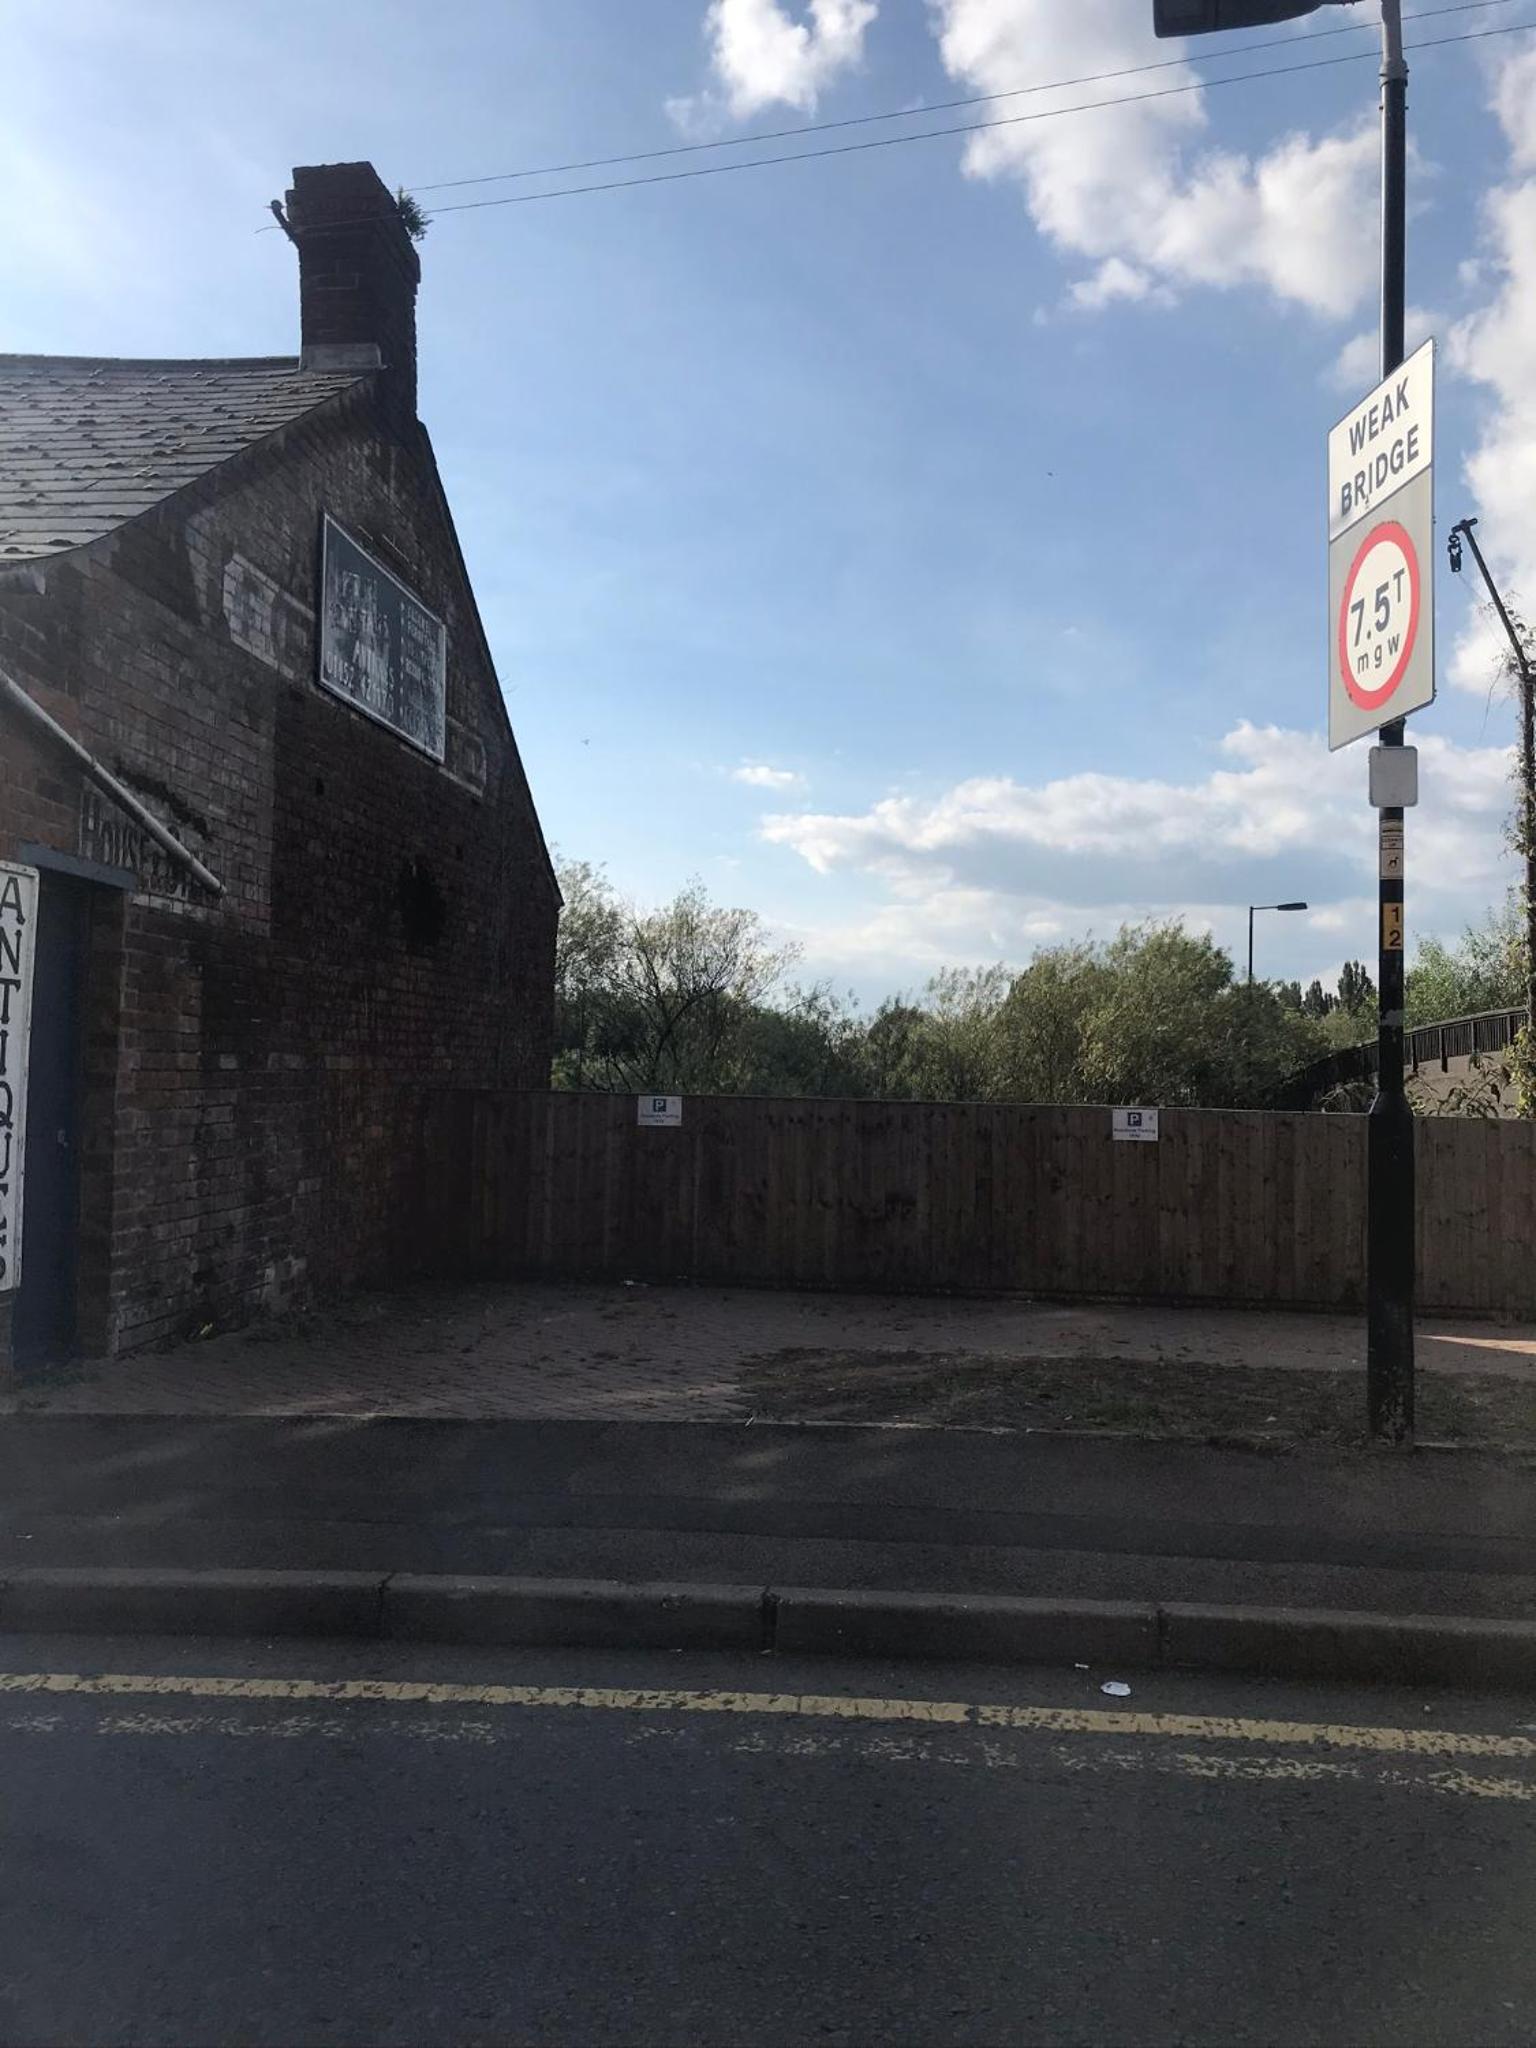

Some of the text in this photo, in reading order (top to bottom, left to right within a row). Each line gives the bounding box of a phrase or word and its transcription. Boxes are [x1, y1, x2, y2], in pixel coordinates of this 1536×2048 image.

[1348, 376, 1410, 456] WEAK
[1340, 424, 1419, 517] BRIDGE
[1389, 930, 1401, 947] 2
